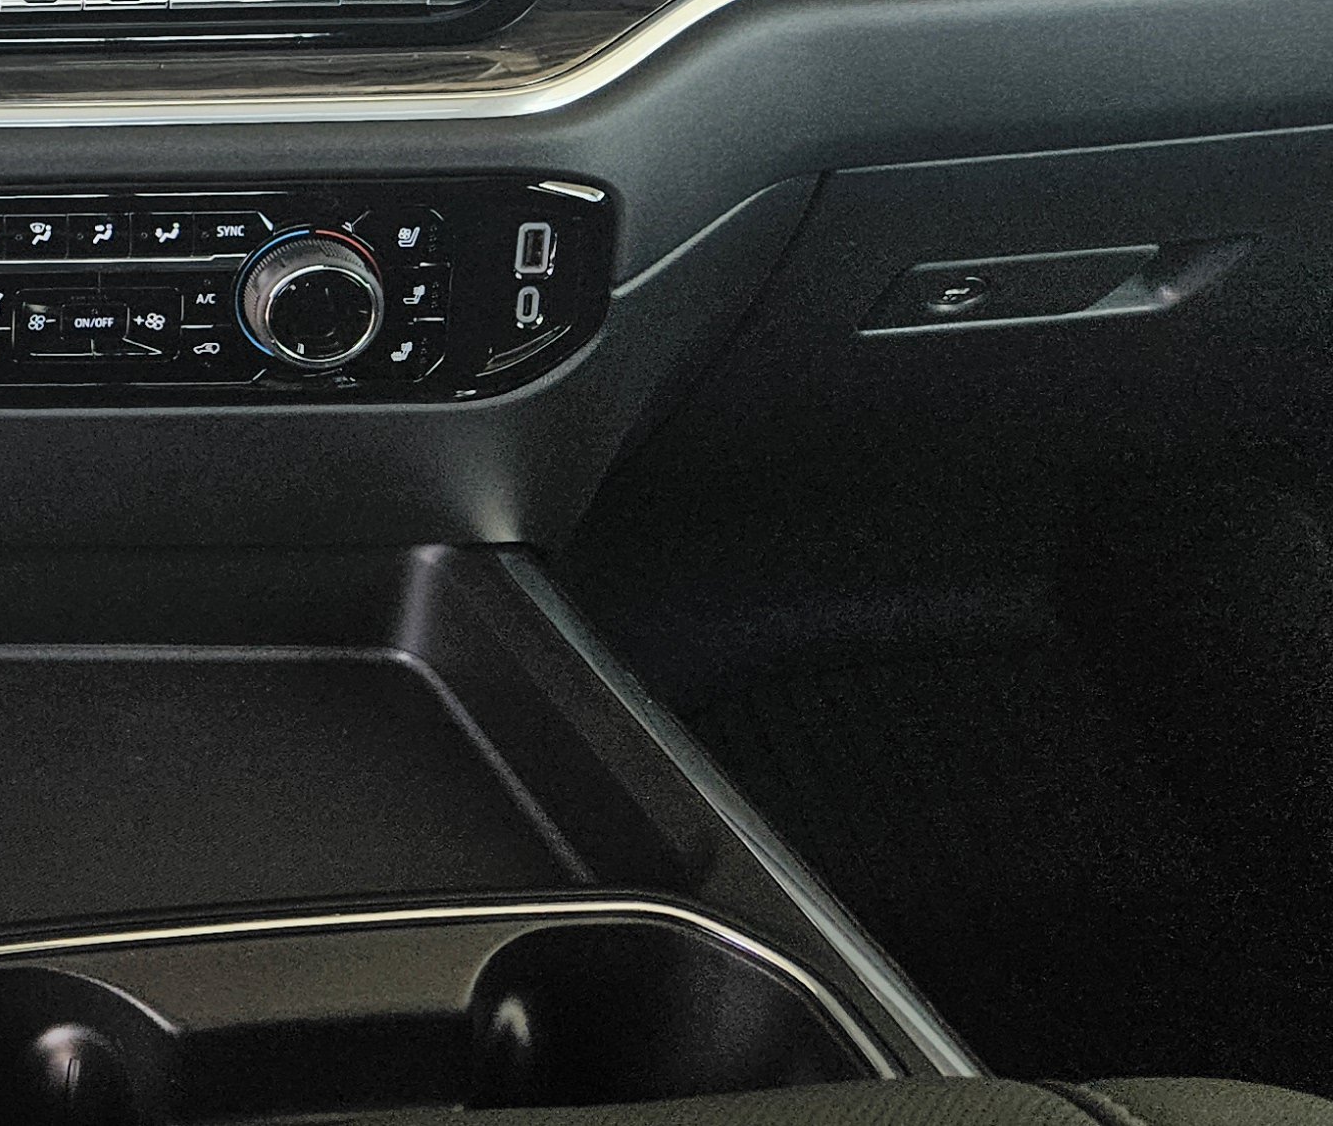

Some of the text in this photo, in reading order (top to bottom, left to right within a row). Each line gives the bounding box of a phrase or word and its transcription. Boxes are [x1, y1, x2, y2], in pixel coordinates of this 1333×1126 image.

[216, 224, 245, 238] SYNC
[195, 293, 216, 305] A/C
[74, 317, 115, 329] ON/OFF
